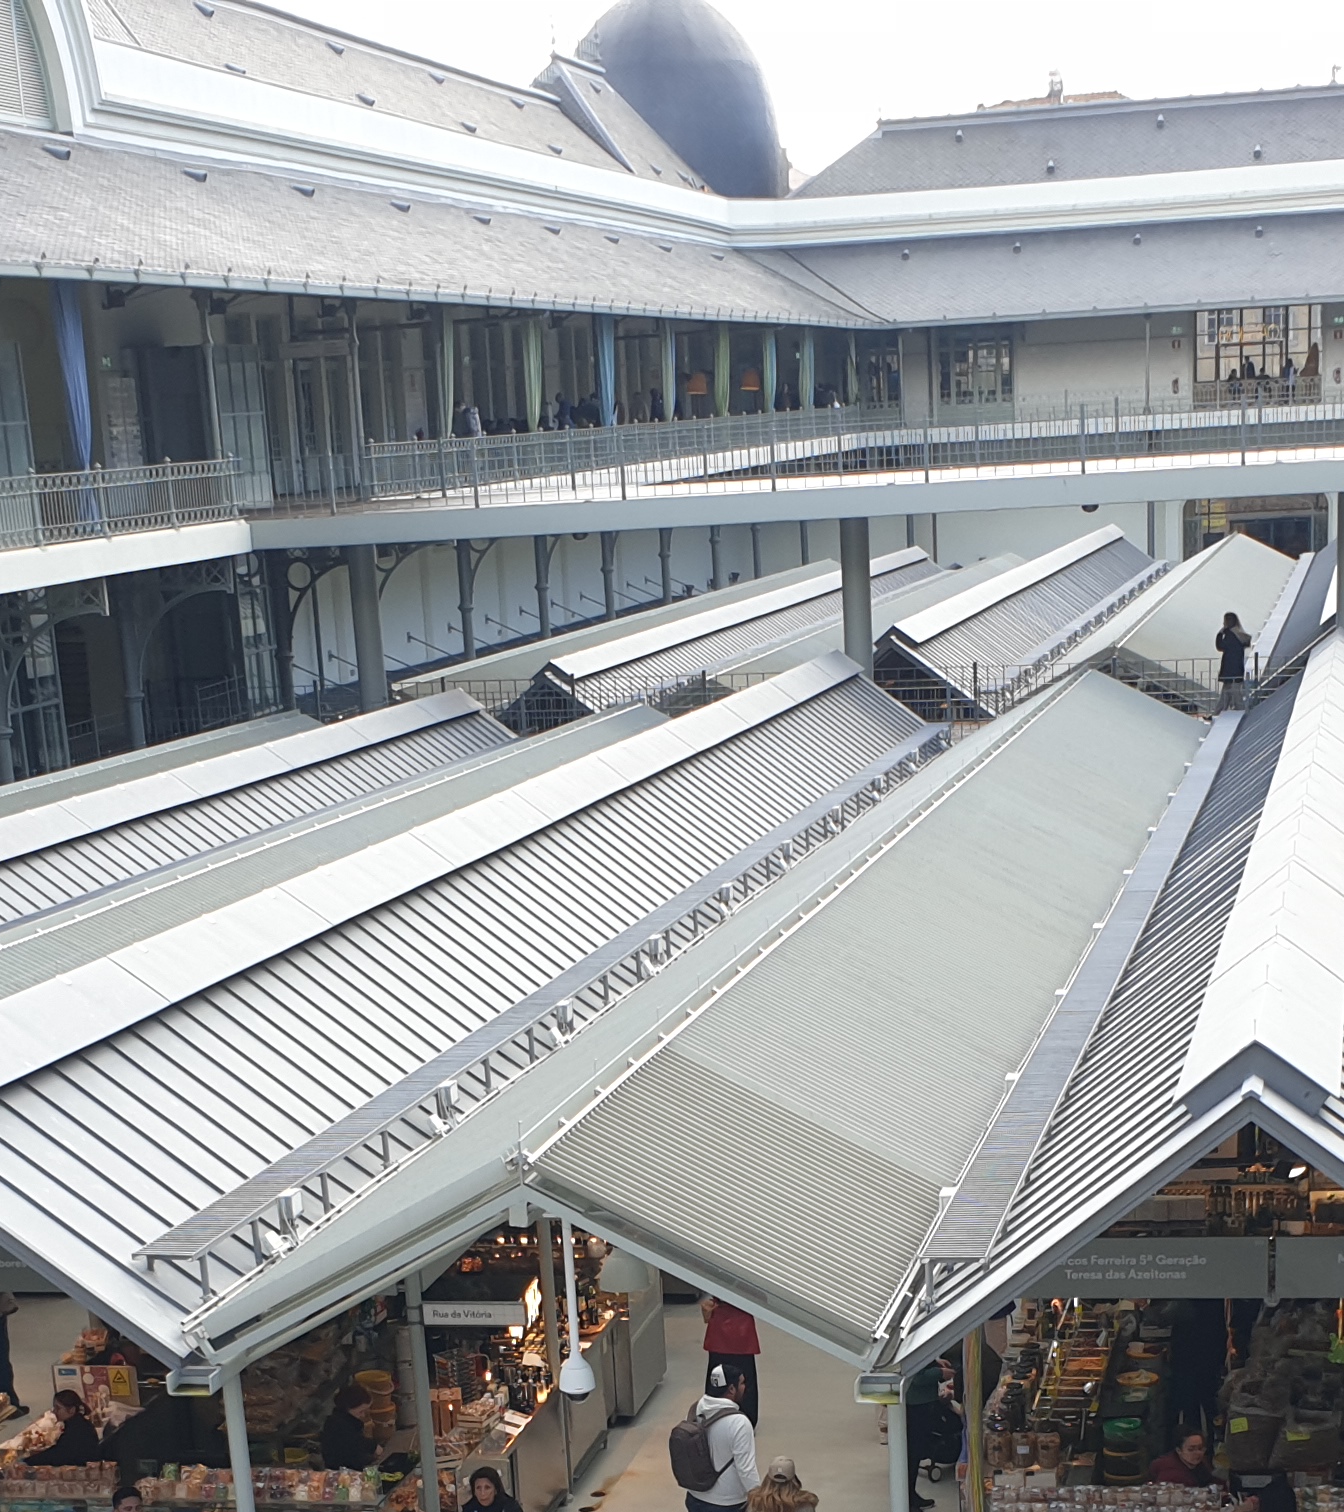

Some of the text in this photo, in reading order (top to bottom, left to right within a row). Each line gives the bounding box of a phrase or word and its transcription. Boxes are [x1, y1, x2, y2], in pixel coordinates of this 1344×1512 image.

[1057, 1254, 1207, 1268] rcos Ferreira 5ª Geração
[1064, 1269, 1187, 1280] Teresa das Azeitonas
[432, 1309, 492, 1319] Rua da Vitória
